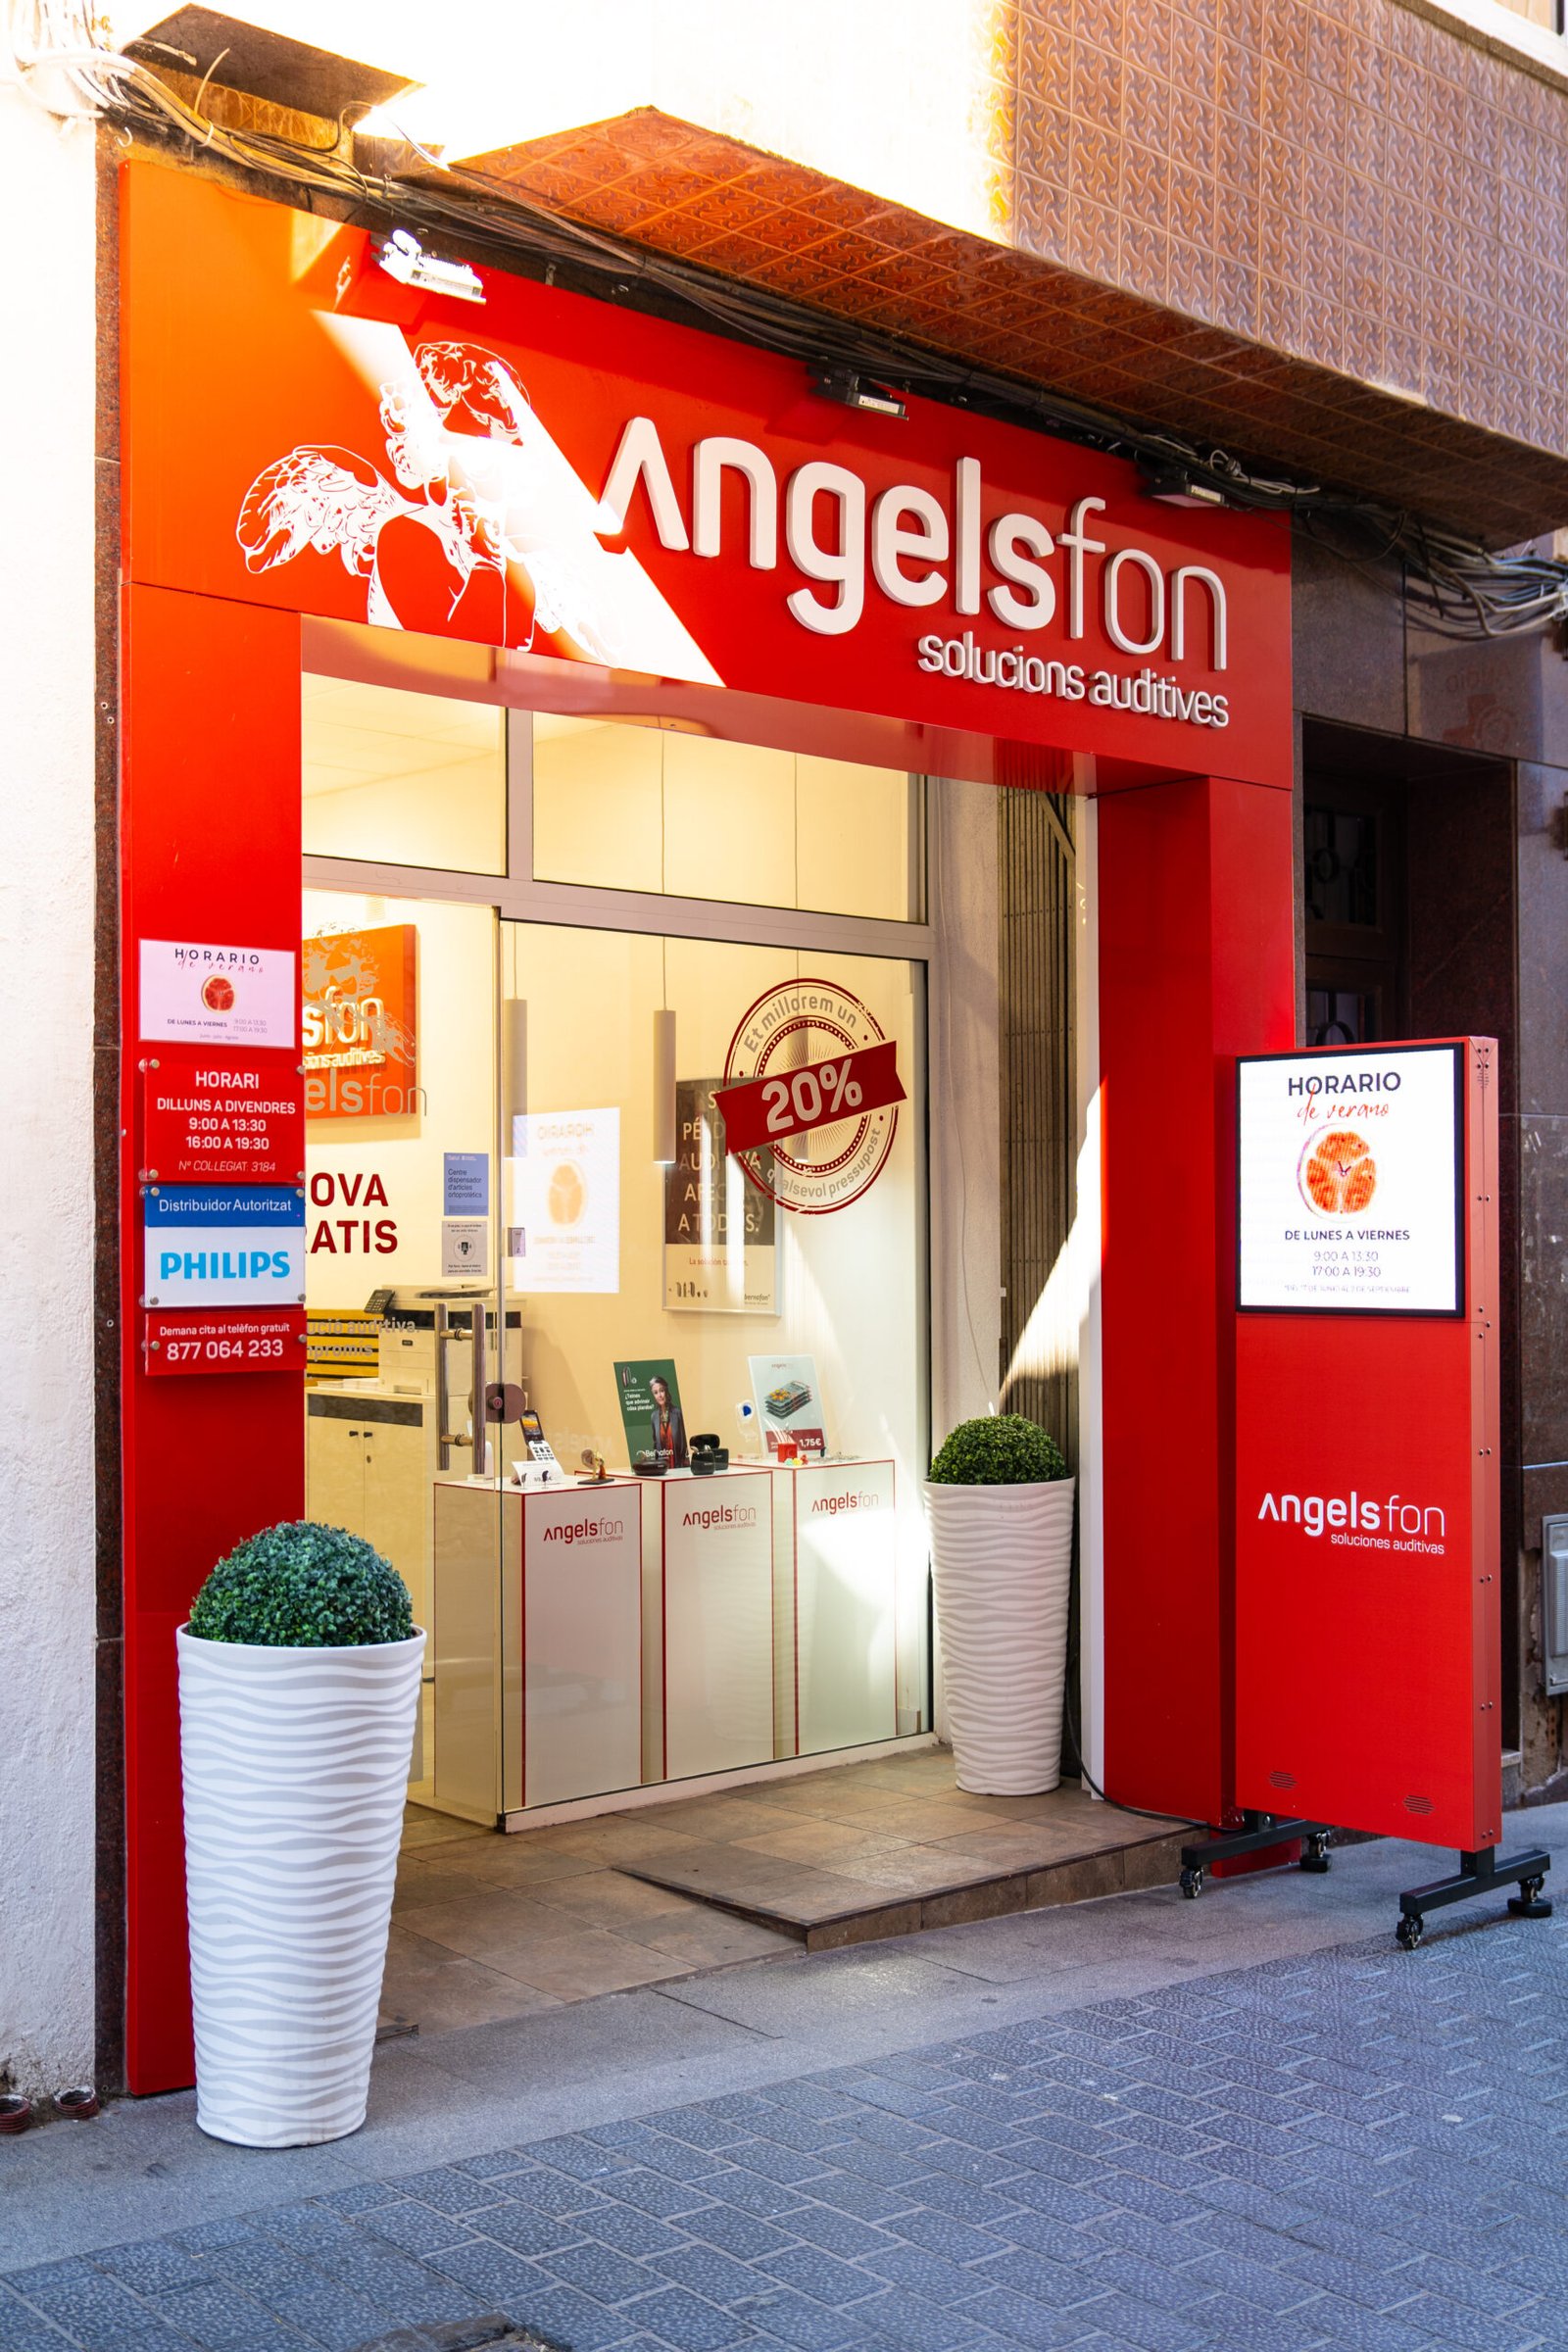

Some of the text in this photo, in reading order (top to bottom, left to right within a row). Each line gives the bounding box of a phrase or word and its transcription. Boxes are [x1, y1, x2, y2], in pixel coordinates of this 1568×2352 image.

[918, 631, 1230, 729] solucions auditives
[174, 948, 260, 965] HORARIO
[744, 995, 858, 1054] Et millorem un
[196, 1071, 259, 1089] HORARI
[1288, 1071, 1401, 1097] HORARIO
[760, 1058, 863, 1133] 20%
[1297, 1083, 1390, 1126] de verano
[157, 1098, 296, 1114] DILLUNS A DIVENDRES
[188, 1117, 267, 1132] 9:00 A 13:30
[185, 1136, 270, 1151] 16:00 A 19:30
[251, 1161, 276, 1172] 3184
[766, 1127, 881, 1199] qalsevol pressupost
[305, 1172, 389, 1206] OVA
[159, 1199, 291, 1212] Distribuidor Autoritzat
[692, 1213, 760, 1233] TODS.
[305, 1220, 398, 1253] ATIS
[1285, 1230, 1411, 1241] DE LUNES A VIERNES
[160, 1250, 291, 1280] PHILIPS
[1341, 1250, 1349, 1261] A
[1343, 1266, 1350, 1276] A
[160, 1325, 197, 1336] Demana
[199, 1324, 217, 1335] cita
[218, 1324, 225, 1334] al
[227, 1323, 259, 1334] telèfon
[167, 1339, 283, 1360] 877 064 233
[799, 1438, 822, 1447] 1,75€
[1330, 1532, 1446, 1555] soluciones auditivas
